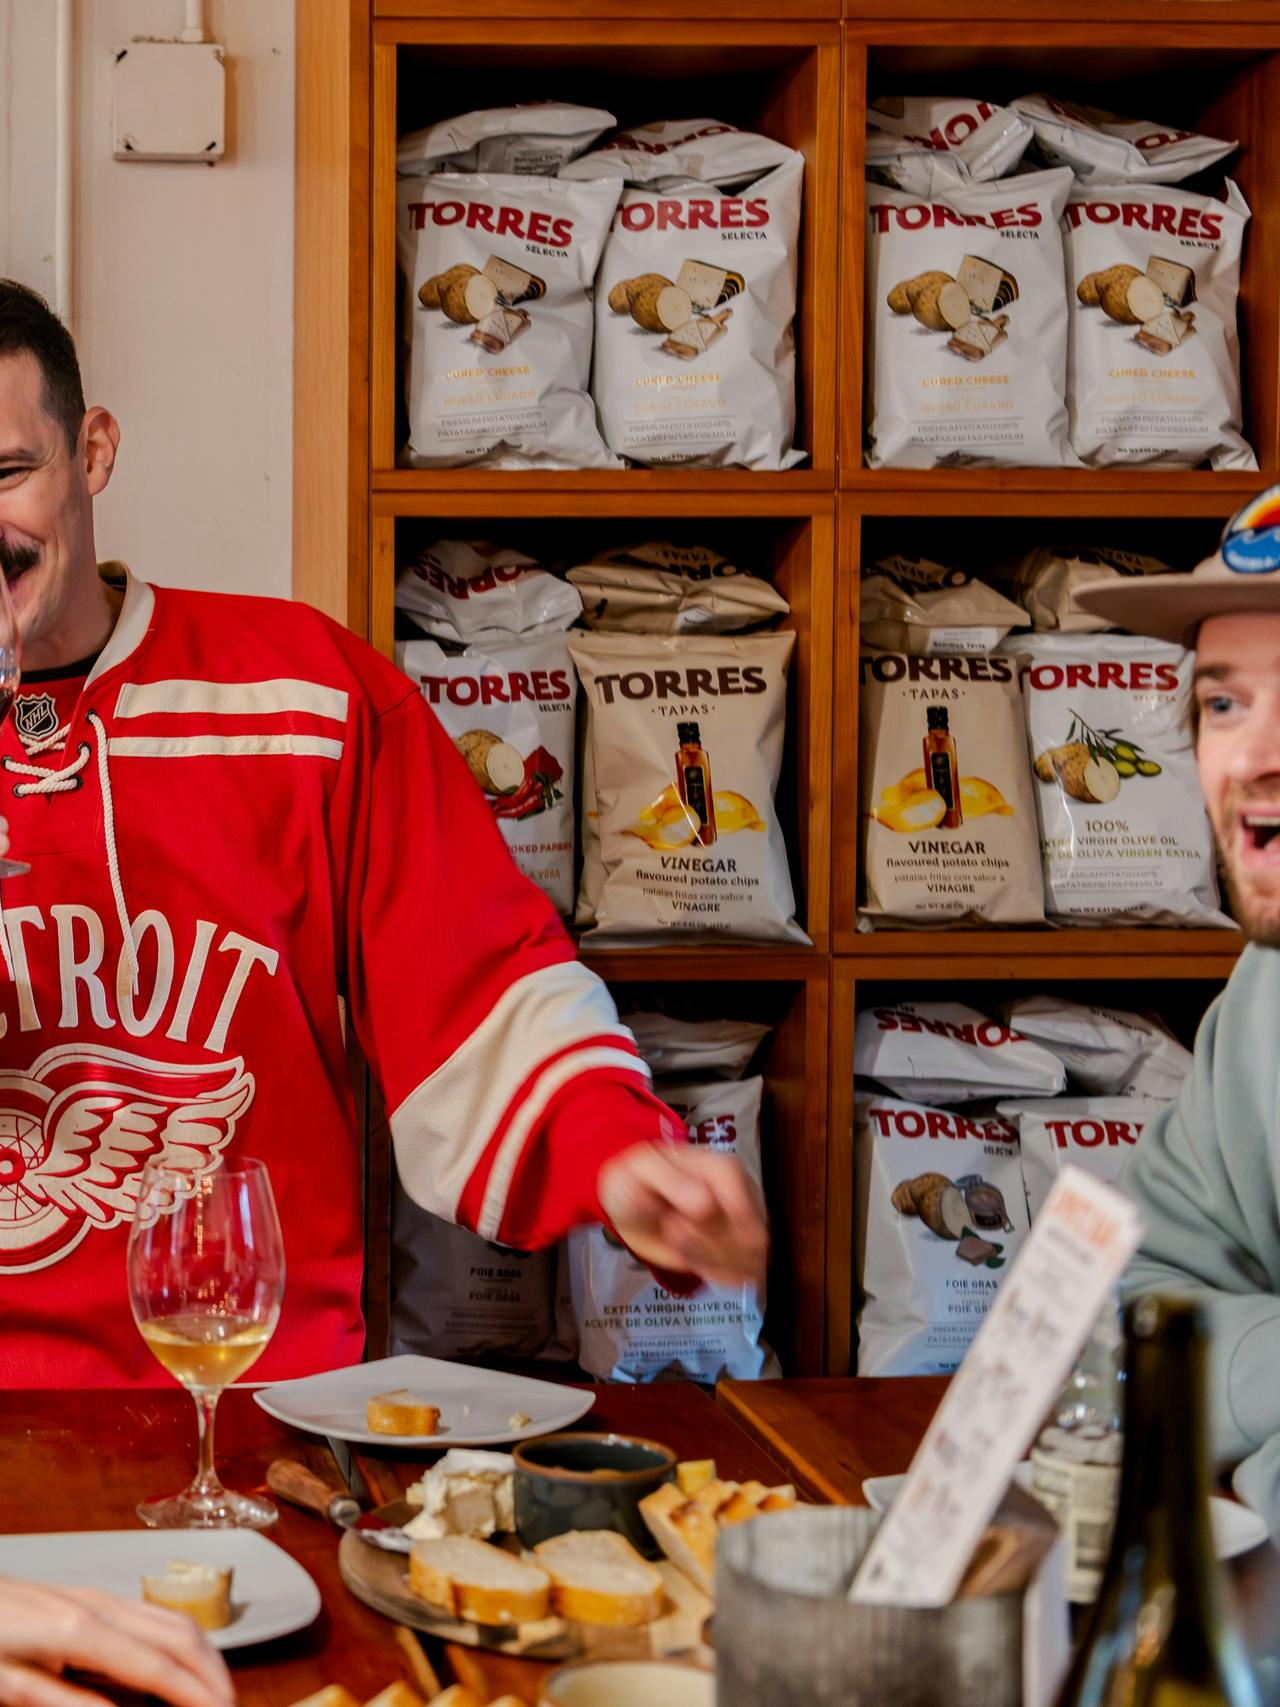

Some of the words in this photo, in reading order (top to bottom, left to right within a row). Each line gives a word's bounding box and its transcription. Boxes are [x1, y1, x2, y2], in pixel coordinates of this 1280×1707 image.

[407, 201, 574, 249] TORRES
[1063, 202, 1224, 241] TORRES
[721, 231, 767, 241] SELECTA
[1000, 230, 1039, 240] SELECTA
[525, 244, 569, 259] SELECTA
[1180, 239, 1220, 251] SELECTA
[421, 670, 572, 706] TORRES
[594, 666, 768, 705] TORRES
[908, 687, 960, 701] TAPAS
[538, 703, 572, 712] SELECTA
[657, 704, 710, 717] TAPAS
[25, 704, 47, 730] NHL
[1086, 819, 1129, 833] 100%
[1076, 836, 1118, 847] VIRGIN
[1121, 835, 1157, 845] OLIVE
[1160, 834, 1178, 846] OIL
[908, 841, 986, 855] VINEGAR
[1076, 849, 1114, 860] OLIVA
[1118, 849, 1162, 859] VIRGEN
[1165, 849, 1202, 860] EXTRA
[660, 855, 737, 873] VINEGAR
[886, 857, 939, 868] flavoured
[942, 857, 978, 868] potato
[981, 857, 1009, 869] chips
[636, 869, 687, 884] flavoured
[690, 873, 728, 887] potato
[730, 876, 760, 888] chips
[926, 883, 975, 894] VINAGRE
[671, 899, 721, 913] VINAGRE
[1043, 1120, 1144, 1149] TOR
[945, 1279, 968, 1289] FOIE
[971, 1279, 999, 1289] GRAS
[603, 1305, 642, 1315] EXTRA
[644, 1303, 685, 1314] VIRGIN
[688, 1302, 720, 1313] OLIVE
[723, 1301, 742, 1311] OIL
[625, 1317, 641, 1328] DE
[648, 1316, 682, 1327] OLIVA
[684, 1315, 726, 1327] VIRGEN
